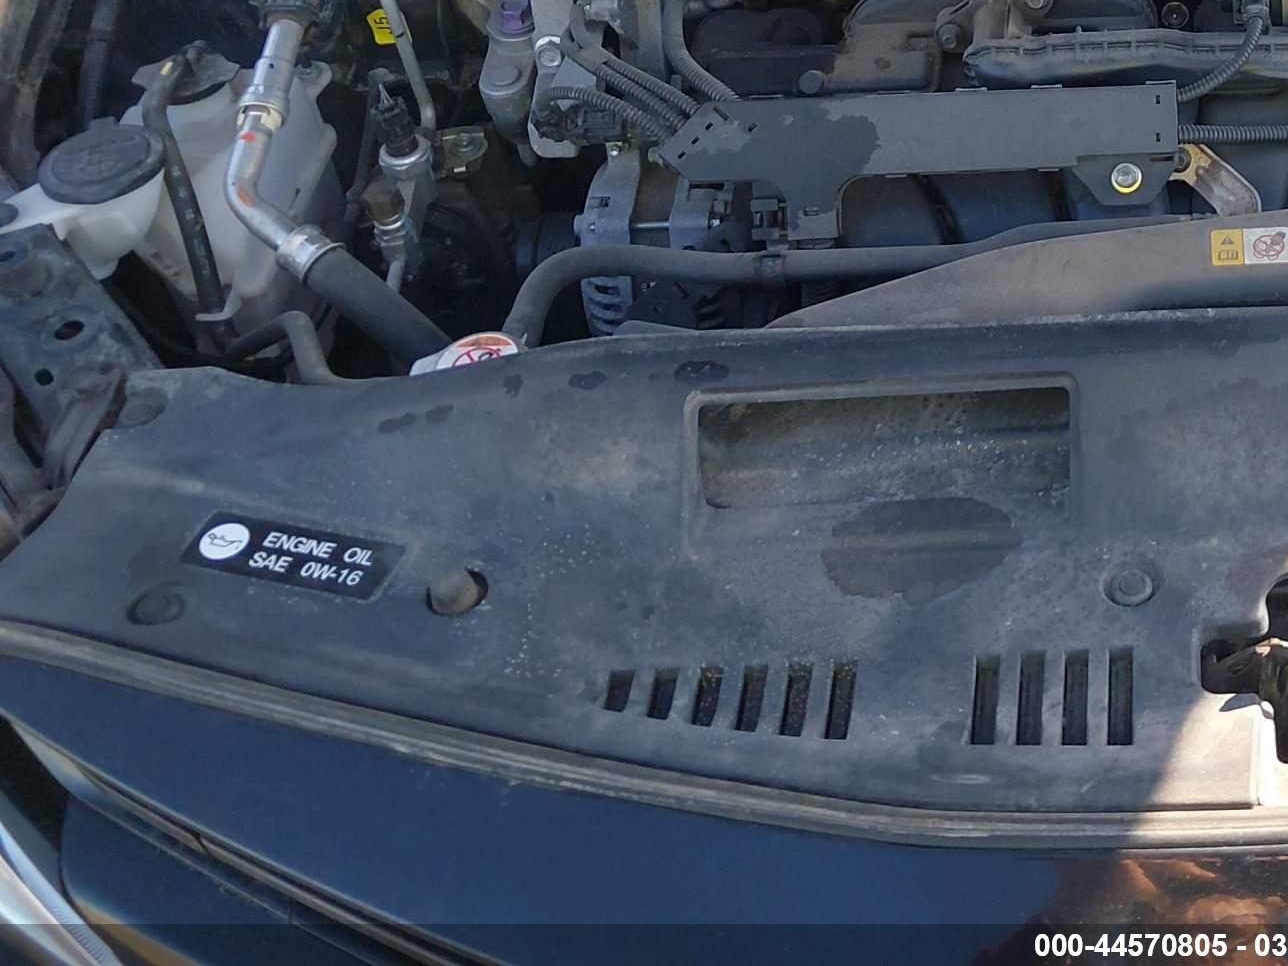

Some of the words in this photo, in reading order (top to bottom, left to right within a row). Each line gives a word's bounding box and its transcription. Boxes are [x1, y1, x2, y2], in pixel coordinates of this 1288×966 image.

[262, 531, 337, 558] ENGINE
[343, 547, 373, 566] OIL
[248, 550, 293, 573] SAE
[300, 561, 363, 586] 0W-16
